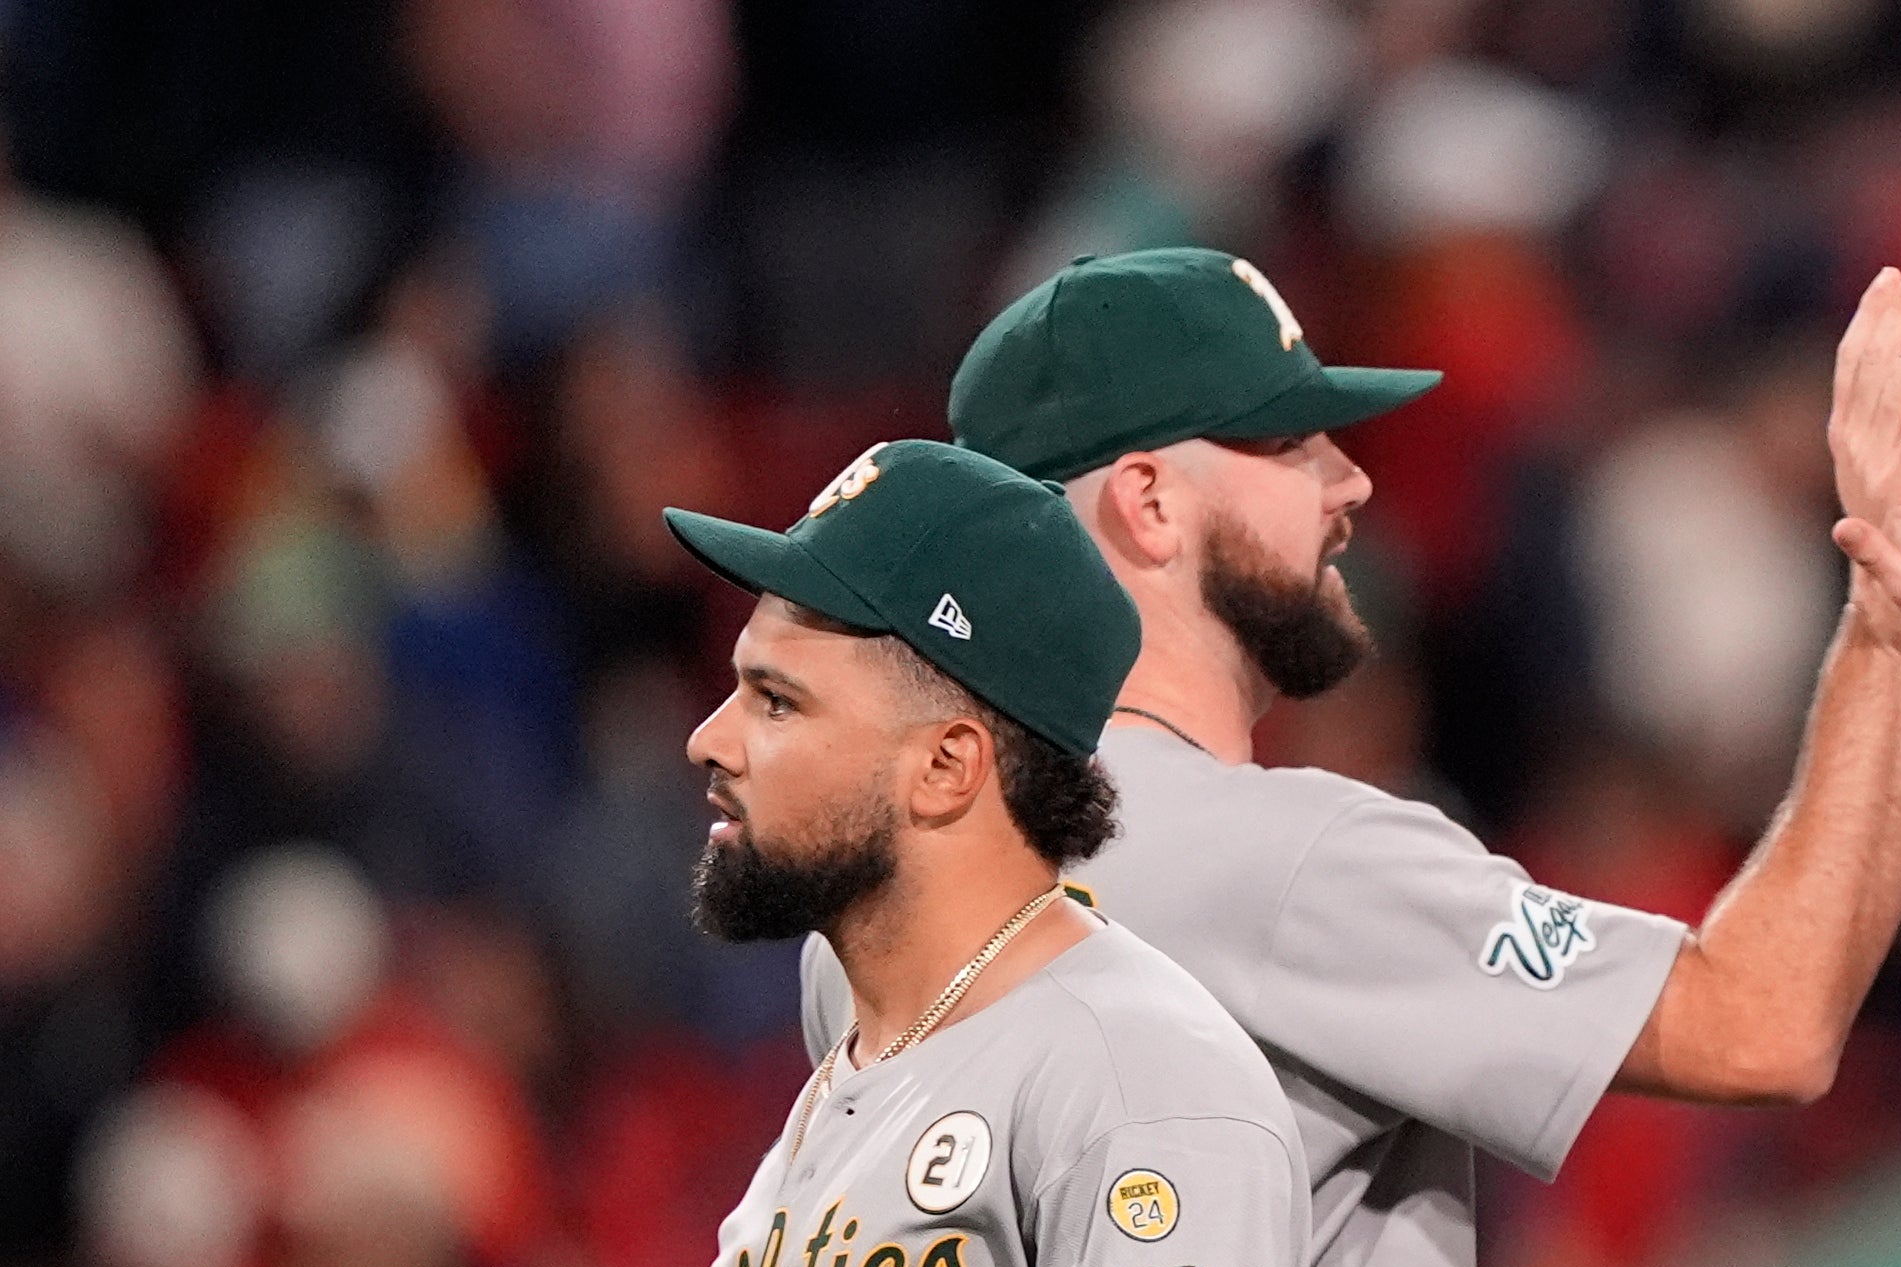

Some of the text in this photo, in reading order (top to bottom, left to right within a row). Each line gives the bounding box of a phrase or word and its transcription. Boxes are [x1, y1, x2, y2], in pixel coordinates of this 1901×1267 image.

[921, 1133, 977, 1189] 21
[1119, 1181, 1160, 1200] RICKEY
[1128, 1199, 1164, 1229] 24
